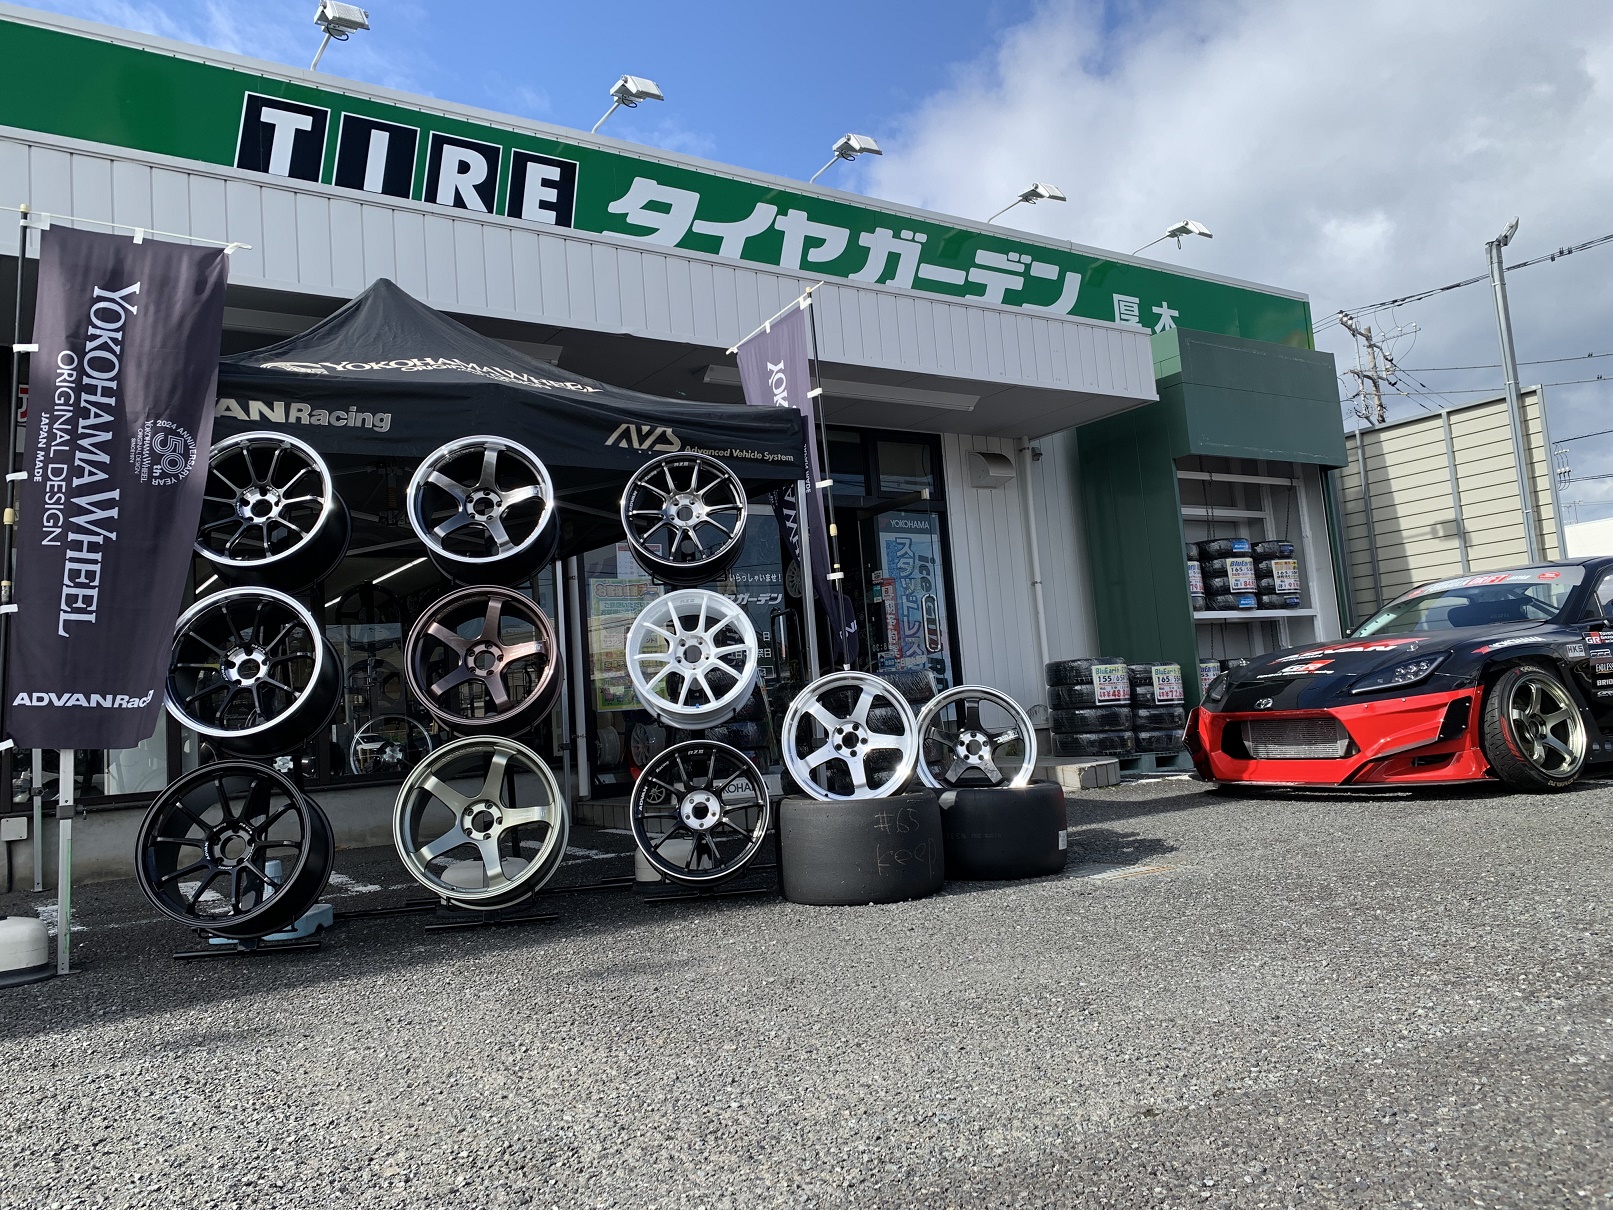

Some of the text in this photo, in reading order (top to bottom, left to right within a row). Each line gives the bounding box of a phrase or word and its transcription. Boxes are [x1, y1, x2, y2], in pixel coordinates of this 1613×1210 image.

[260, 106, 562, 225] TIRE
[602, 176, 1082, 315] タイヤガーデン
[1112, 293, 1180, 333] 厚木
[33, 412, 50, 482] JAPAN MADE
[42, 350, 78, 546] ORIGINAL DESIGN
[151, 420, 197, 486] 2024 ANNIVERSARY YEAR
[604, 422, 682, 452] AVS
[684, 445, 794, 463] Advanced Vehicle System
[889, 518, 931, 530] YOKOHAMA
[1567, 644, 1584, 654] HKS
[1585, 636, 1601, 645] GR
[638, 786, 648, 812] ADVAN
